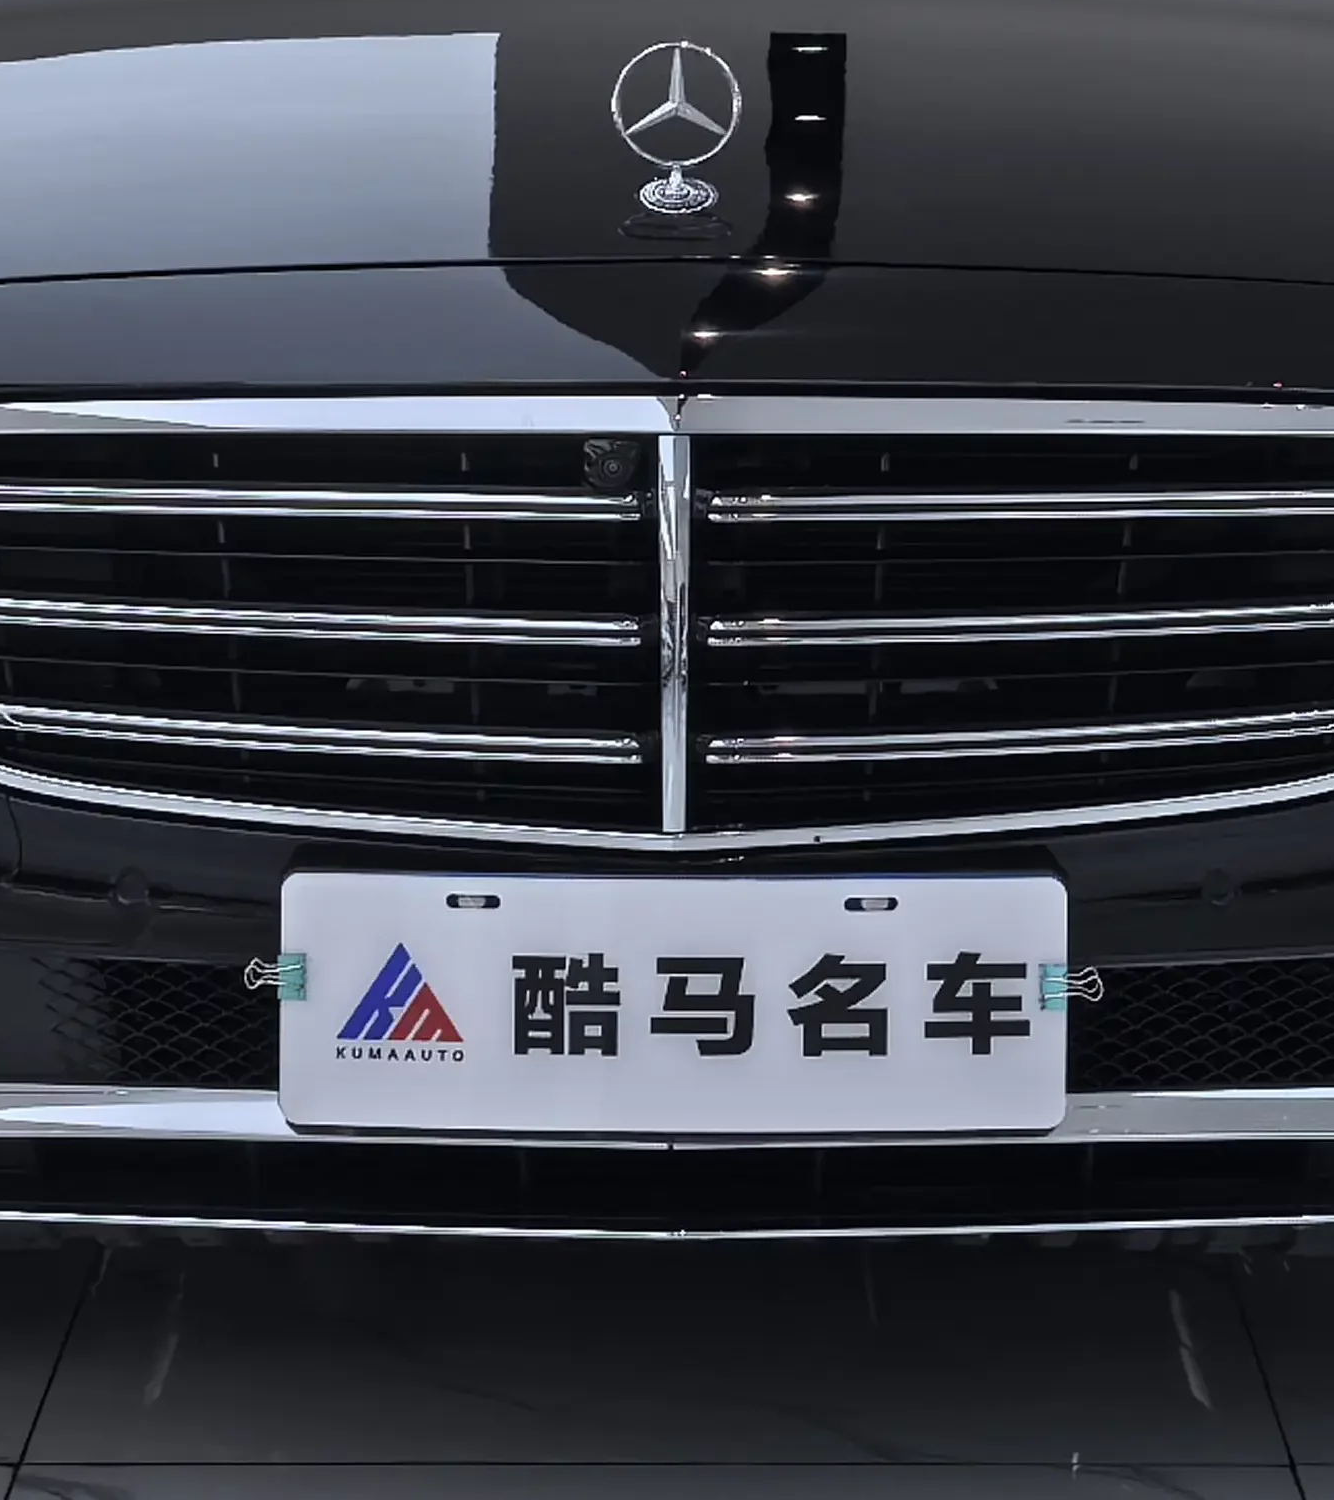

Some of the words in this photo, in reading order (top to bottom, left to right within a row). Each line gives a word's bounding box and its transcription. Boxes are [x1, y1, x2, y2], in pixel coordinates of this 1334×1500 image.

[512, 952, 1031, 1057] 酷马名车
[336, 1047, 464, 1062] KUMAAUTO
